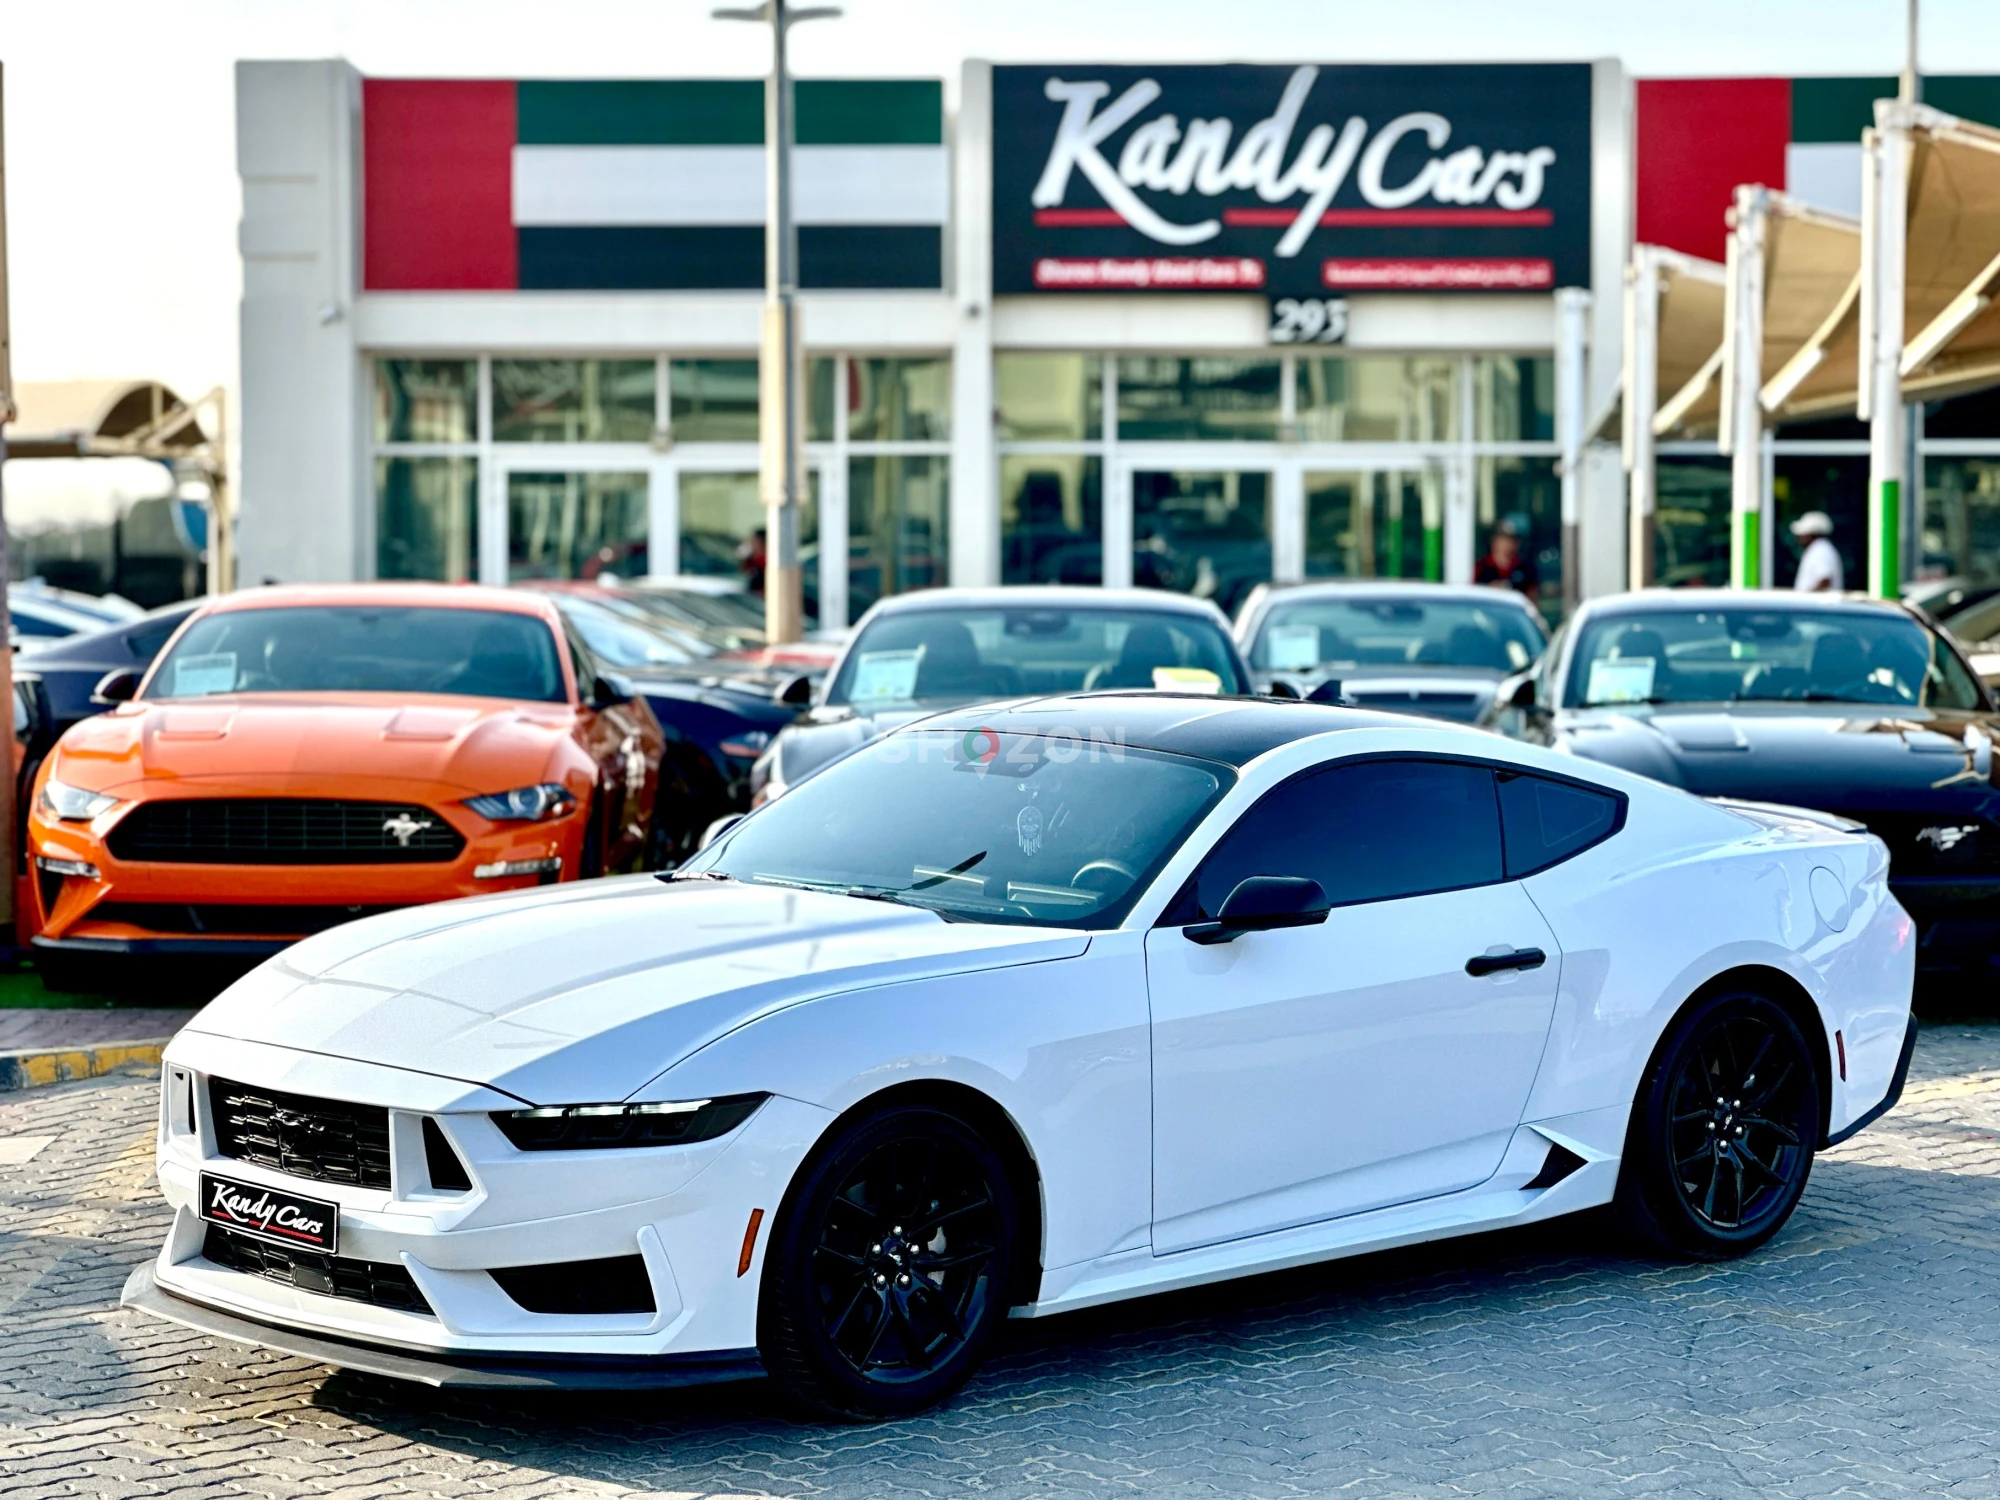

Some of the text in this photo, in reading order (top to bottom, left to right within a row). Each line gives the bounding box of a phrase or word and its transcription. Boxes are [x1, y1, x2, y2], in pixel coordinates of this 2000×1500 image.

[1033, 65, 1554, 256] Kandy Cars
[1270, 298, 1347, 343] 295
[211, 1181, 323, 1234] Kandy Cars
